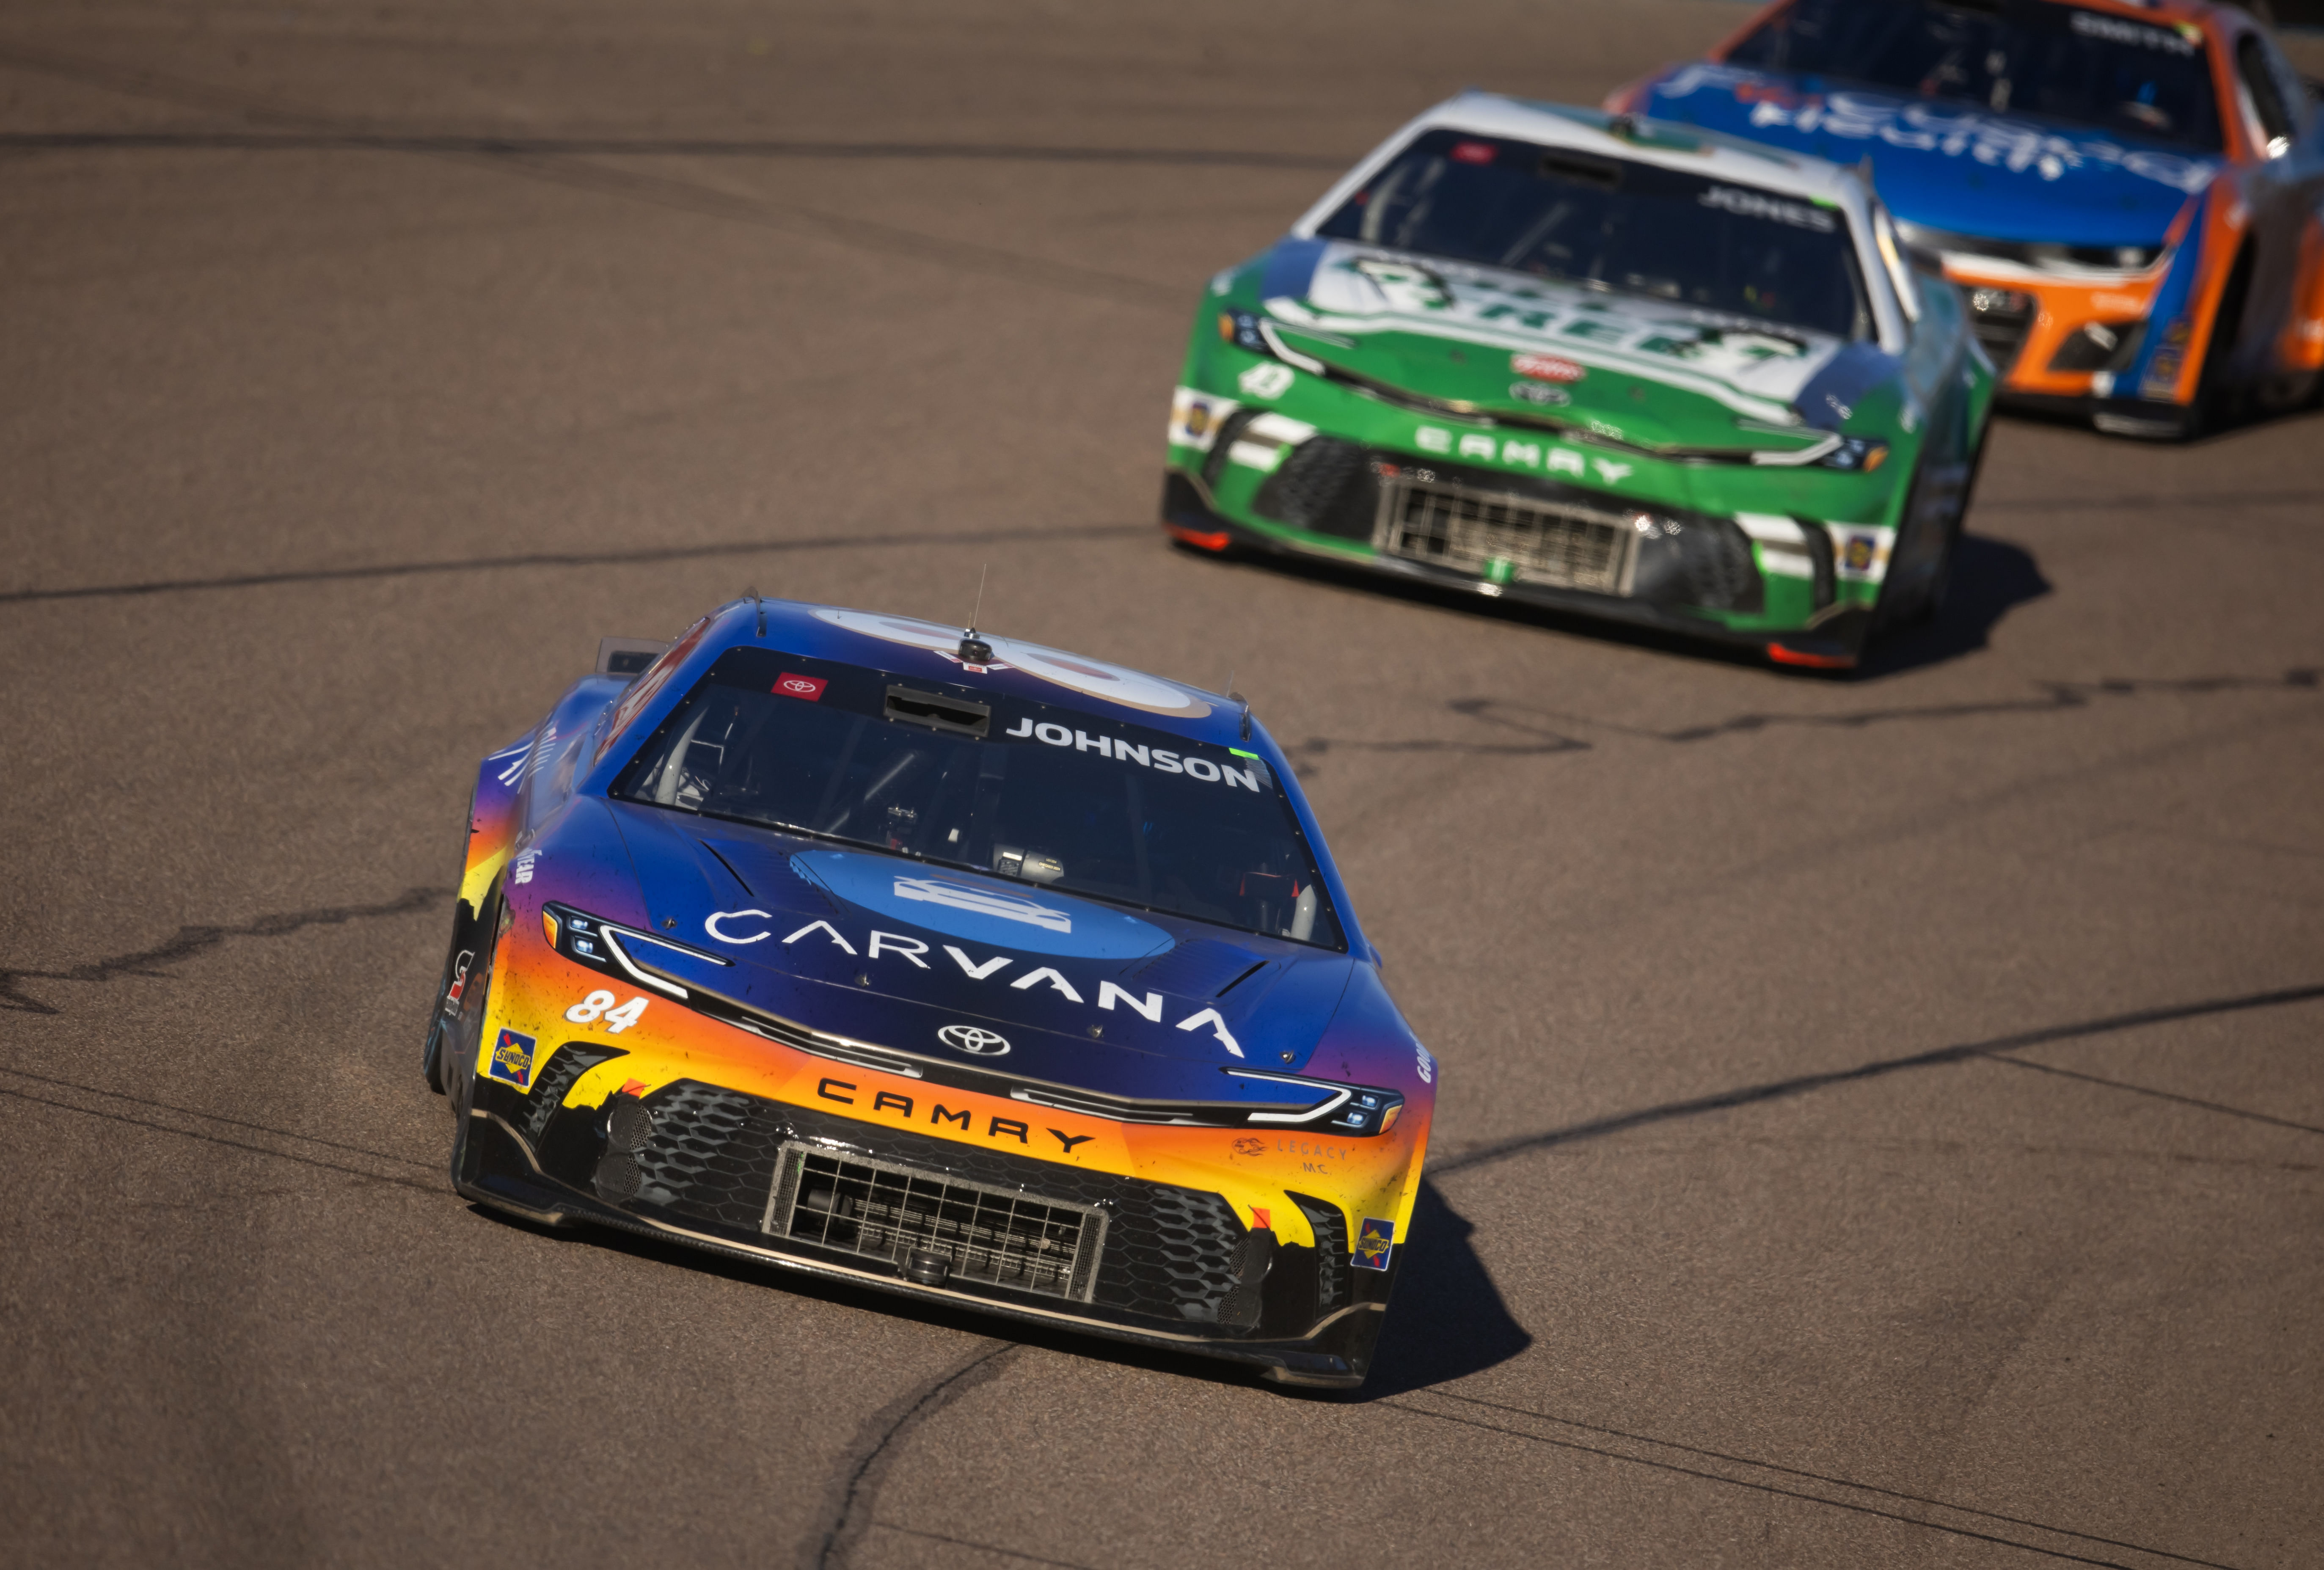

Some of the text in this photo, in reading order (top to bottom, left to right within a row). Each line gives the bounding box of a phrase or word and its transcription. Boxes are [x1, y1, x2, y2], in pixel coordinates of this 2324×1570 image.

[1697, 186, 1836, 232] JONES
[1006, 718, 1260, 793] JOHNSON
[705, 909, 1245, 1058] CARVANA
[563, 989, 649, 1033] 84
[497, 1049, 530, 1068] SUNOCO
[817, 1077, 1096, 1154] CAMRY
[1277, 1139, 1346, 1160] LEGACY
[1358, 1237, 1388, 1252] SUNOCO
